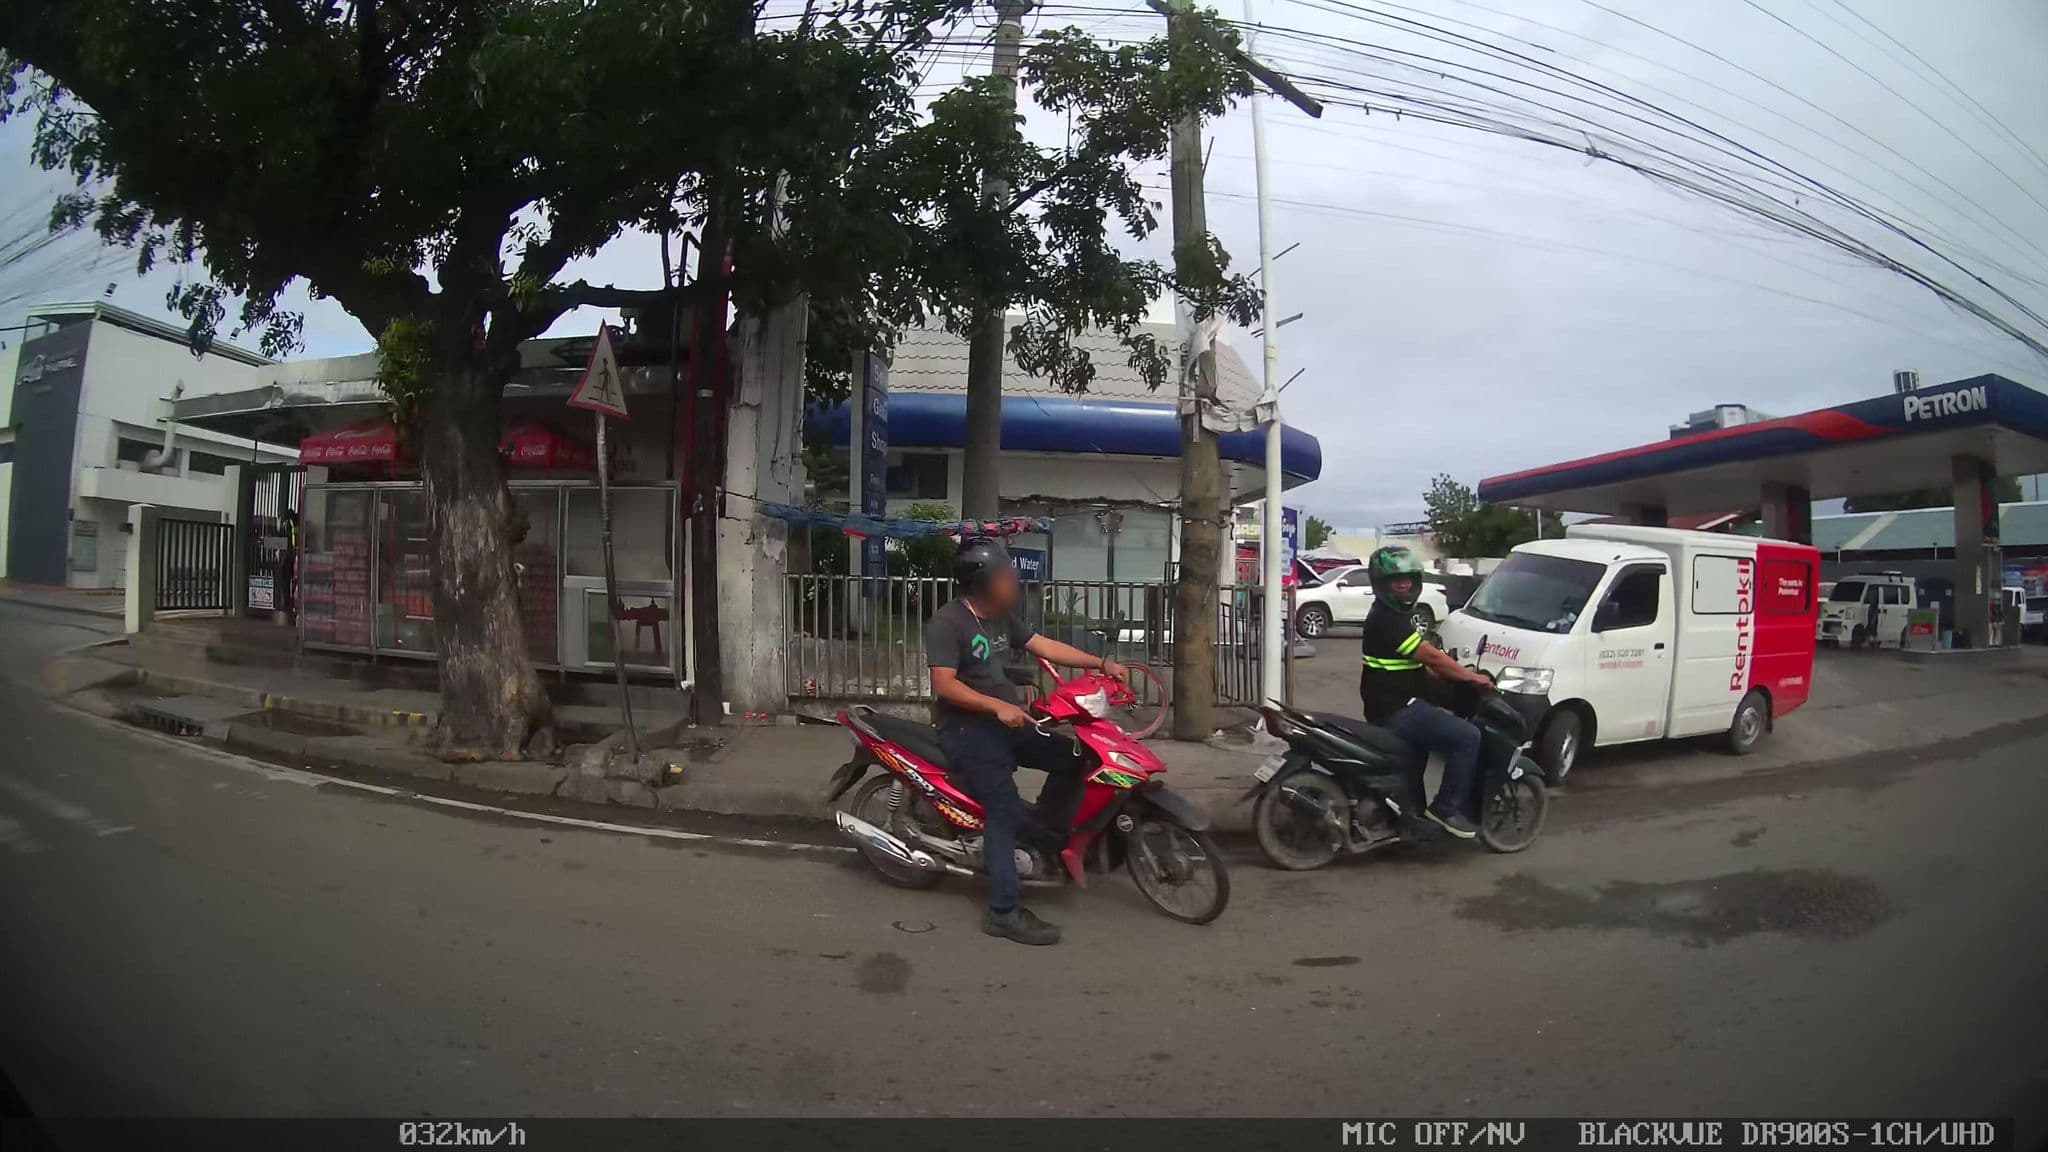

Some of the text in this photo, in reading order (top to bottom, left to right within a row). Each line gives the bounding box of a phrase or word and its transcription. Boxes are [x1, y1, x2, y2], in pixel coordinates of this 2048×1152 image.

[1903, 386, 1987, 422] PETRON
[1019, 556, 1040, 571] Water
[1730, 559, 1751, 691] Rentokil
[1485, 643, 1520, 660] entokil
